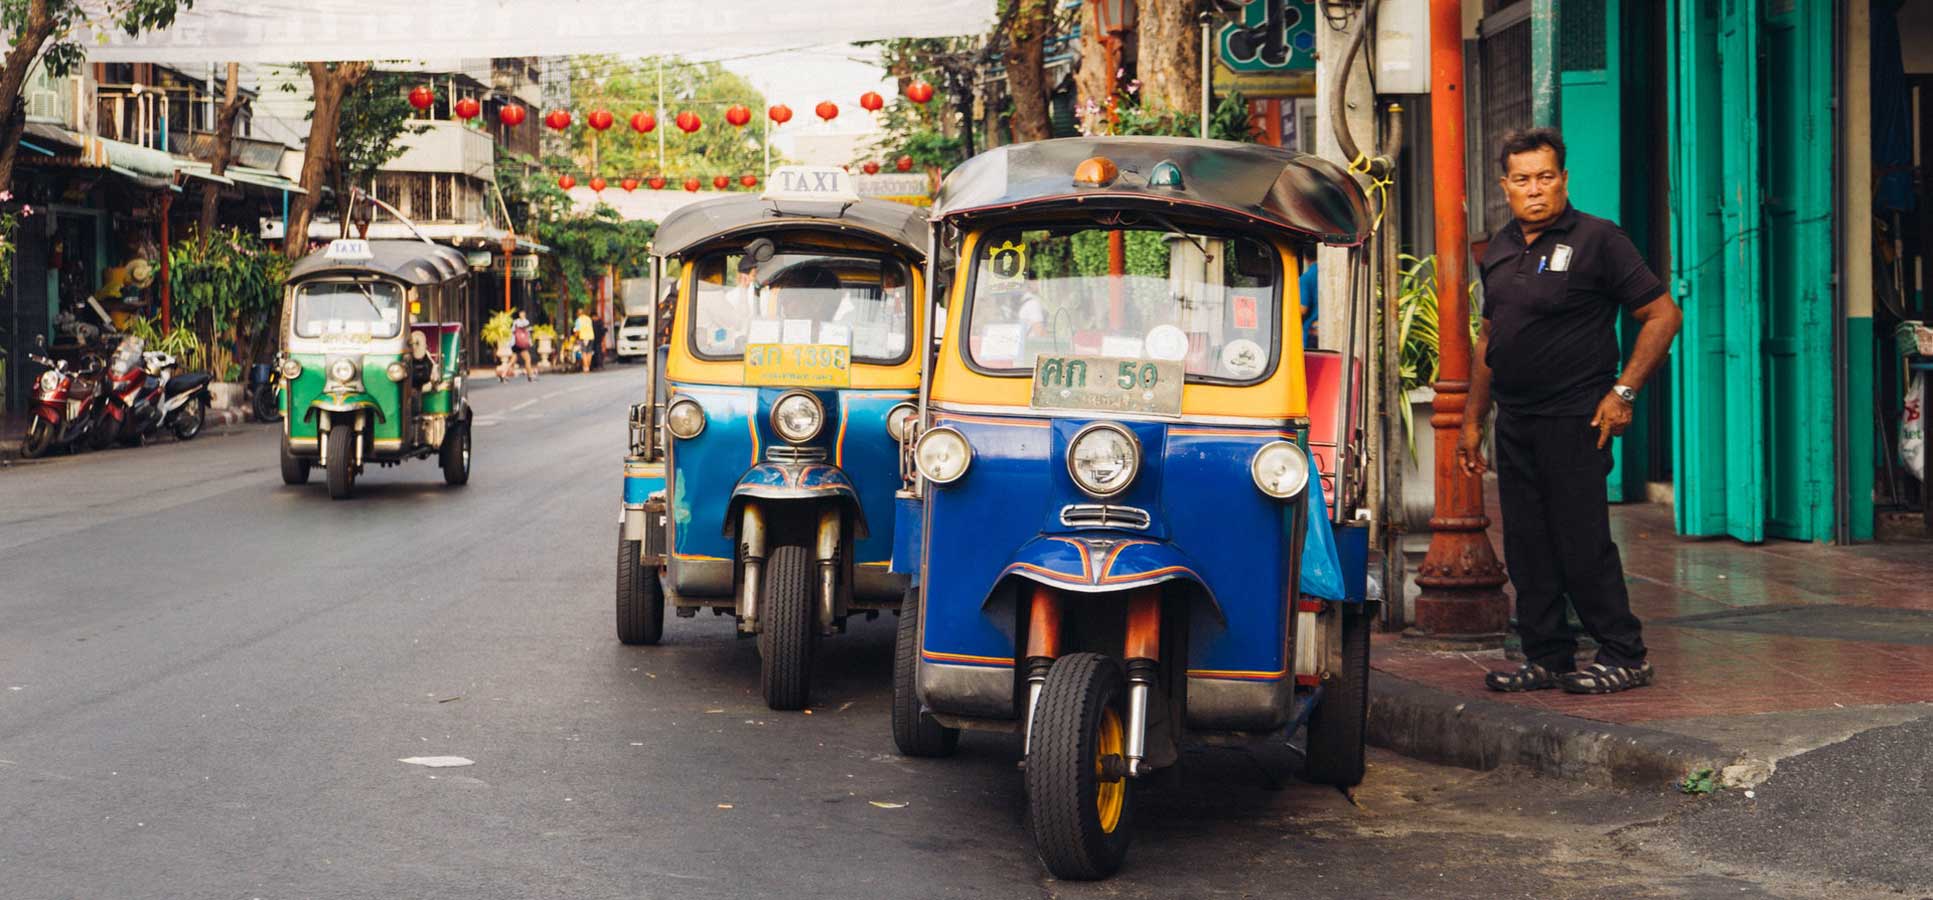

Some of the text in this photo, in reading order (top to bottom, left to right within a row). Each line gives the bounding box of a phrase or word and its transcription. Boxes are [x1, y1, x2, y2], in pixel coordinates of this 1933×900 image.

[780, 171, 839, 192] TAXI
[335, 243, 362, 253] TAXI
[793, 347, 846, 369] 1398
[1117, 361, 1158, 390] 50
